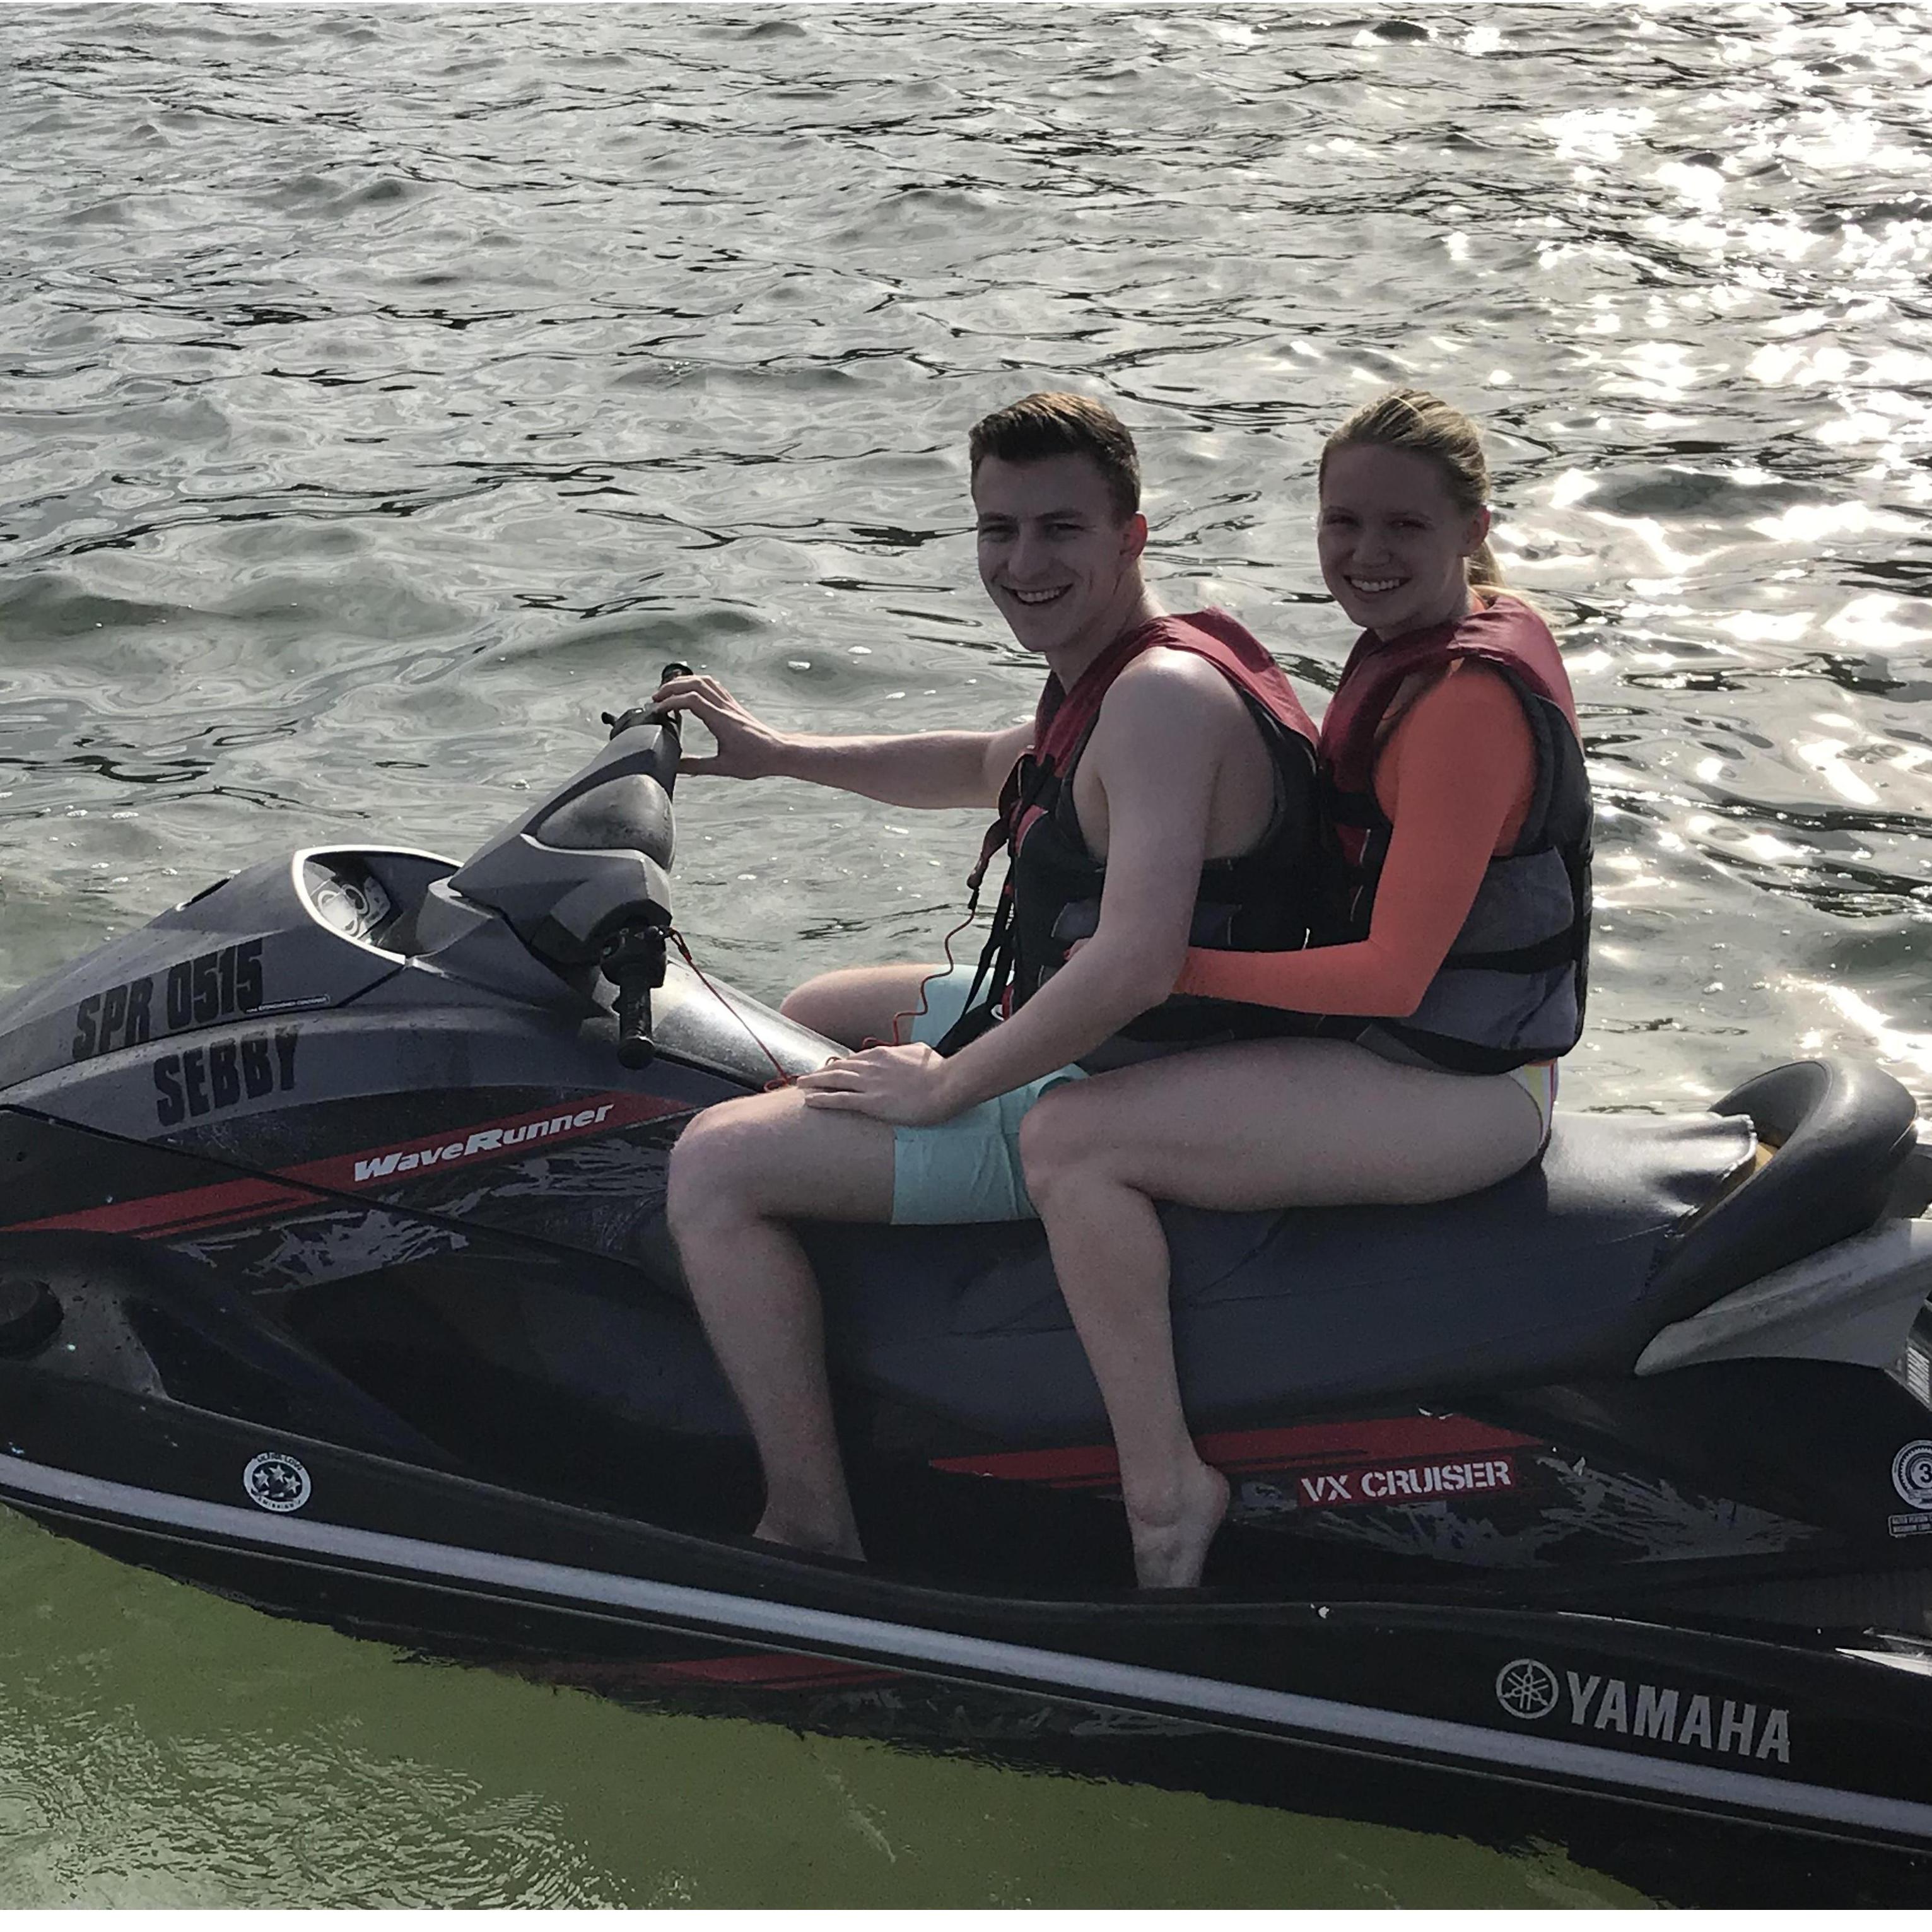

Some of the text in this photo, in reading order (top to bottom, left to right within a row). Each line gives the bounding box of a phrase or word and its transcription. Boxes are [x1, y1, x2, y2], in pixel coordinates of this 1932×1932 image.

[72, 938, 264, 1061] SPR 0515
[153, 1023, 303, 1127] SEBBY
[354, 1104, 614, 1182] WaveRunner
[1301, 1460, 1511, 1502] VX CRUISER
[1919, 1463, 1932, 1483] 3
[1566, 1670, 1791, 1764] YAMAHA
